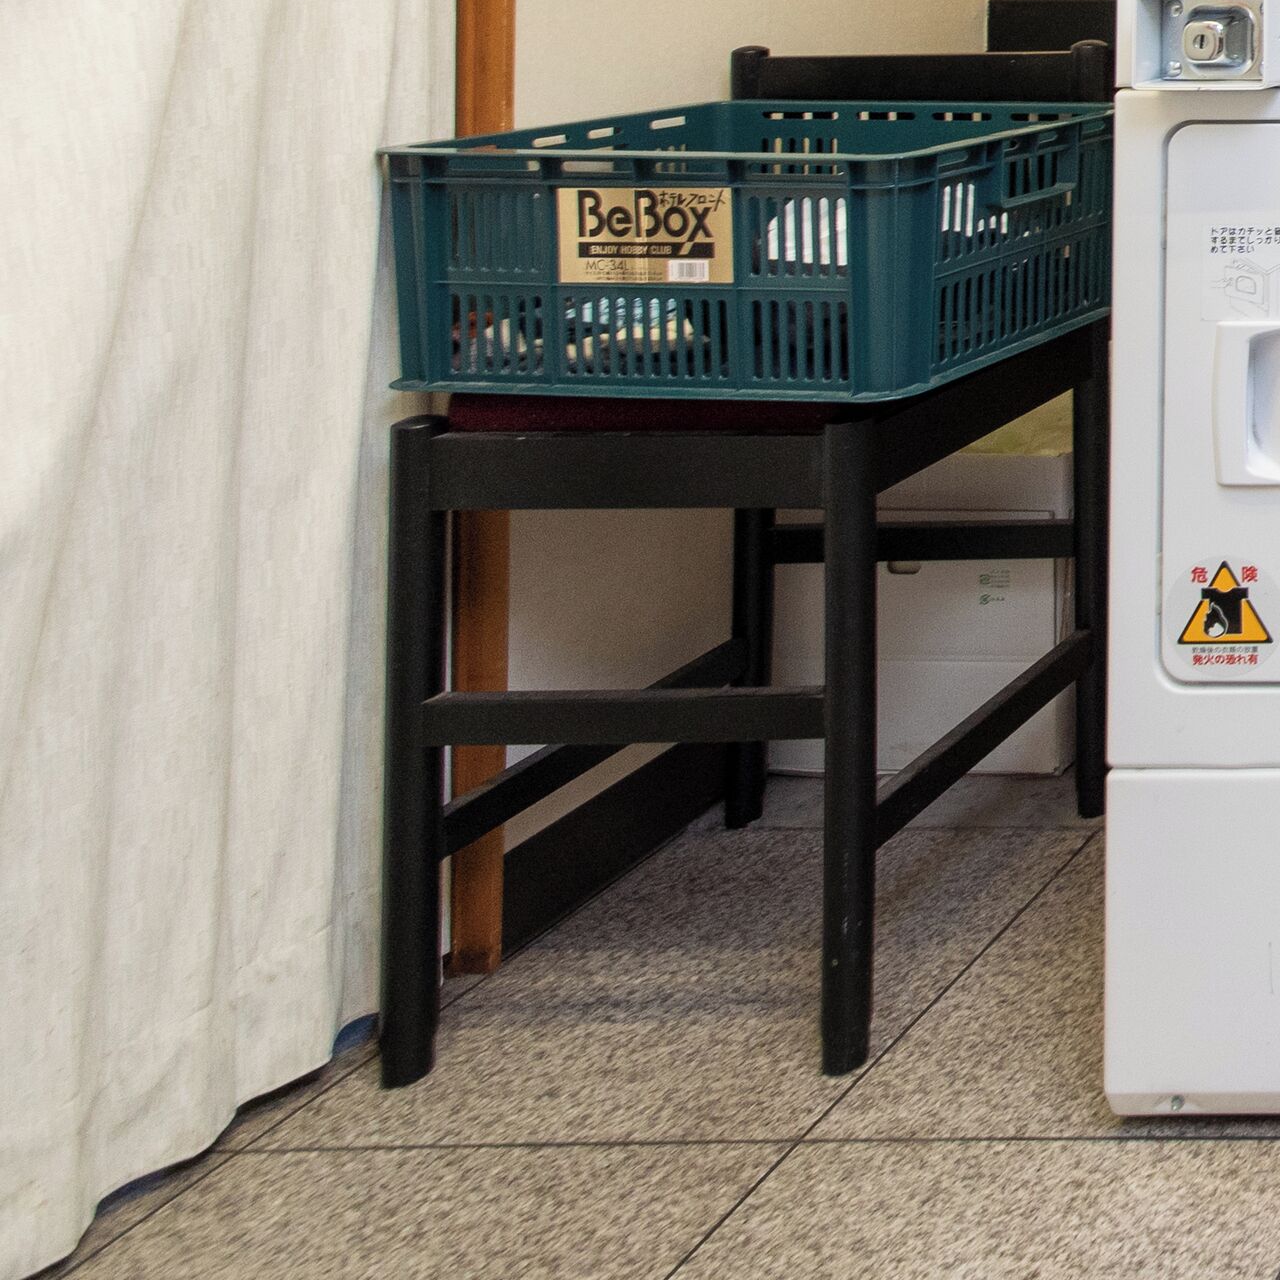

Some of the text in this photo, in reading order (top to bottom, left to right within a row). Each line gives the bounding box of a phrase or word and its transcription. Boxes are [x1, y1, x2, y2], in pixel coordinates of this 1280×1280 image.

[578, 189, 714, 242] BeBox
[590, 245, 672, 255] ENJOY HOBBY CLUB
[1192, 654, 1258, 665] 発火の恐れ有
